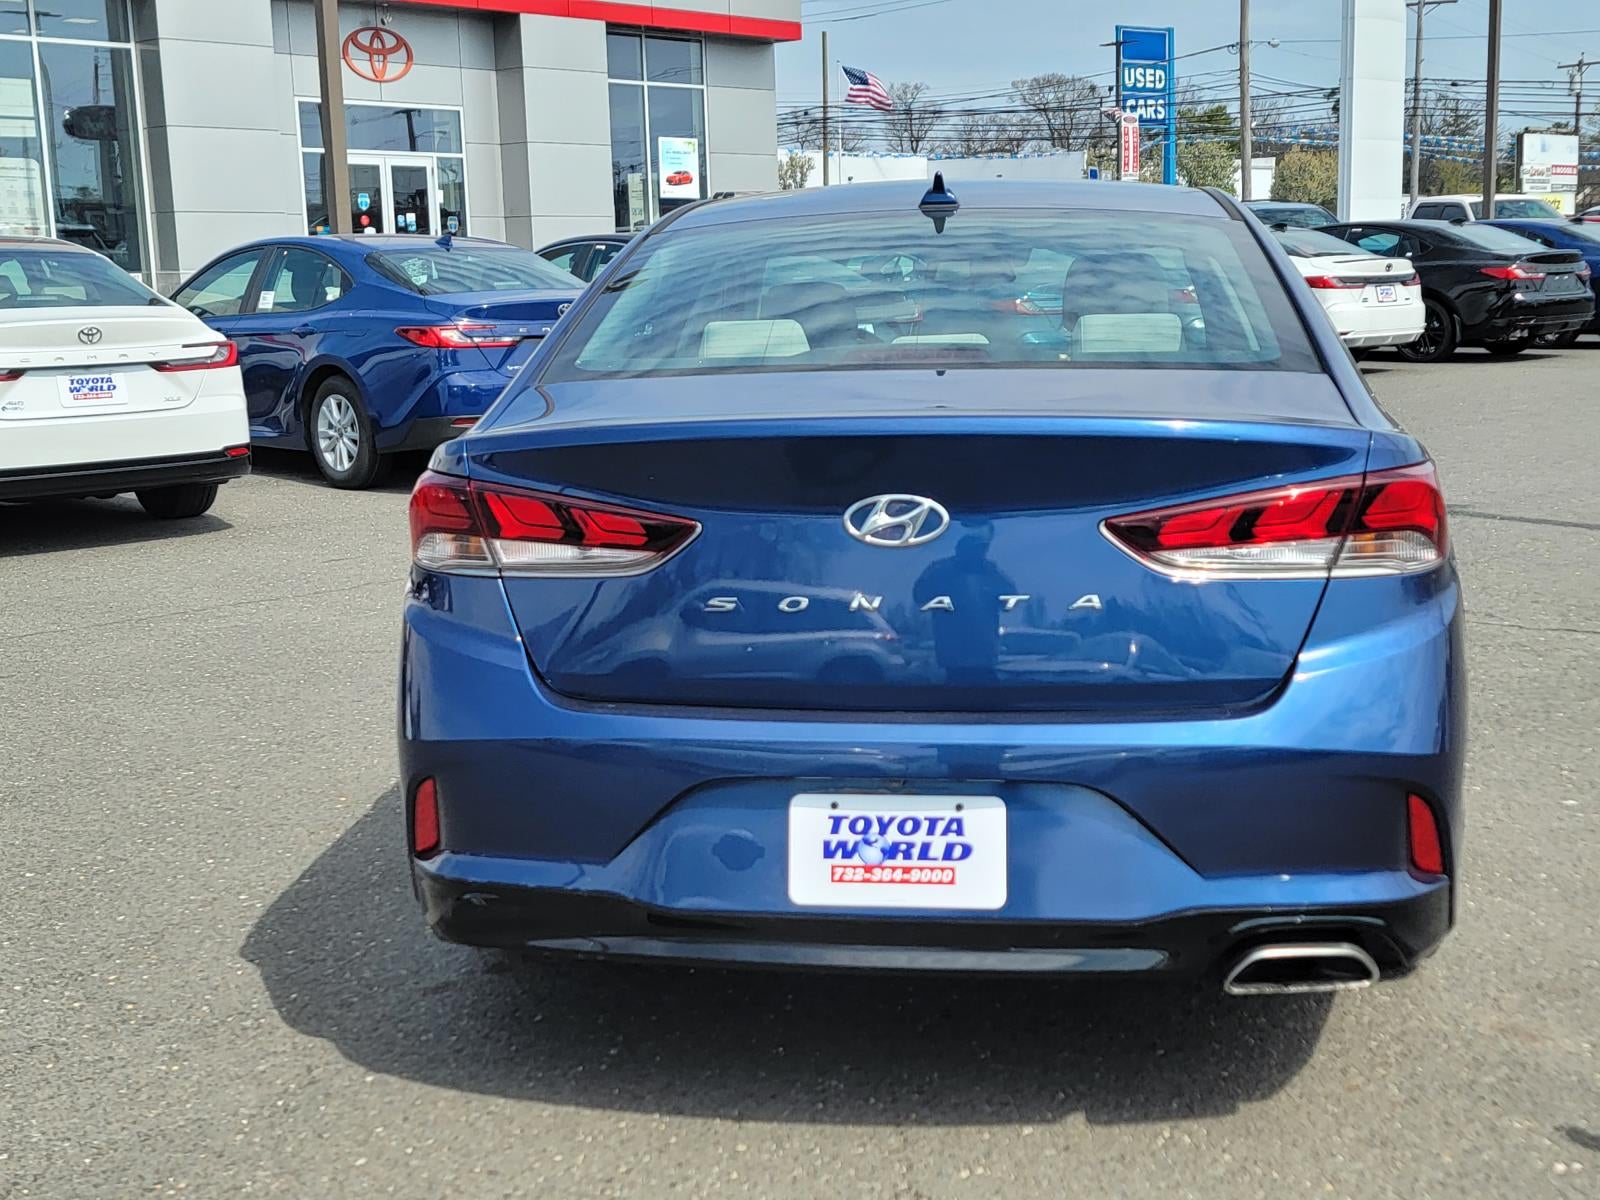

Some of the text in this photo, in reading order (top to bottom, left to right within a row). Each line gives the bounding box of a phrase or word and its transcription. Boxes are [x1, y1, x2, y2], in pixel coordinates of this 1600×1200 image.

[1124, 67, 1166, 89] USED
[1125, 98, 1166, 120] CARS
[69, 376, 113, 386] TOYOTA
[69, 384, 117, 394] WORLD
[703, 592, 1103, 612] SONATA
[828, 815, 966, 837] TOYOTA
[822, 839, 973, 863] WORLD
[832, 866, 954, 882] 732-364-9000
